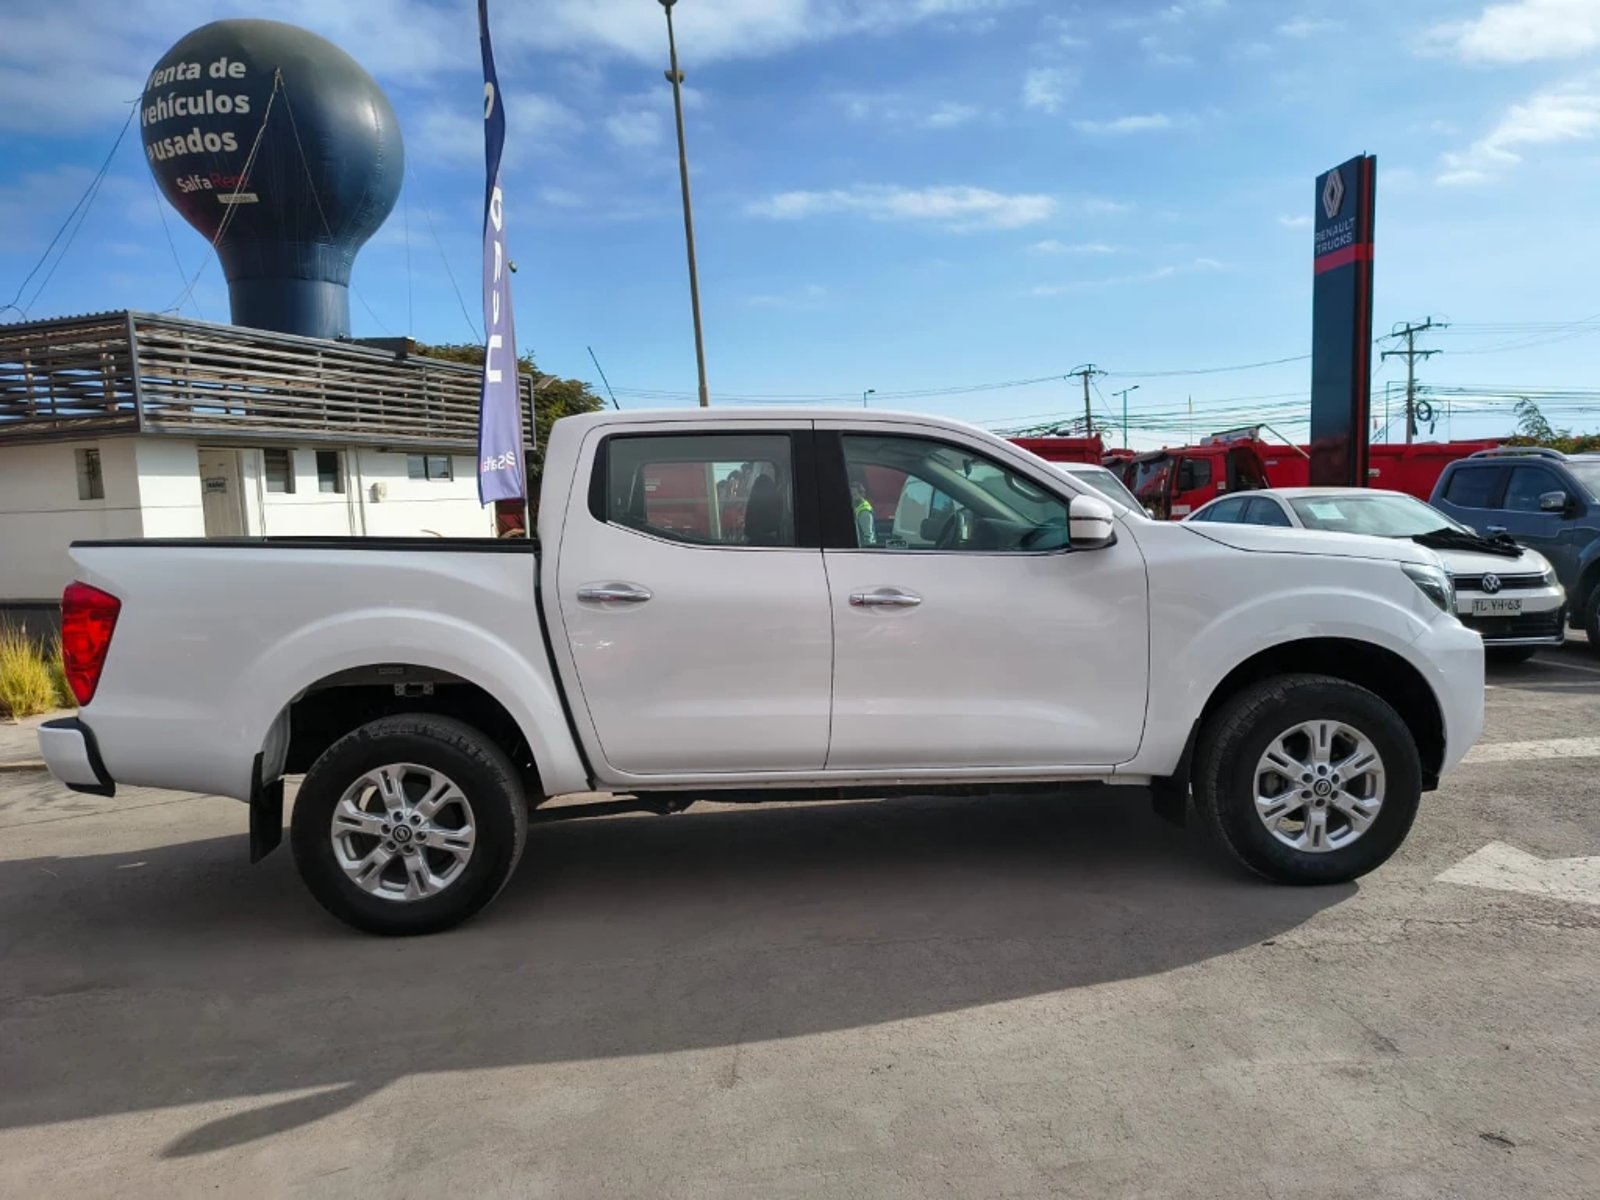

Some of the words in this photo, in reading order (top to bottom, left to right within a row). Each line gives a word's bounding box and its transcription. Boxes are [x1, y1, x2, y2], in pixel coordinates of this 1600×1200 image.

[209, 57, 246, 78] de
[142, 89, 250, 127] vehículos
[1315, 217, 1355, 240] RENAULT
[1316, 233, 1352, 254] TRUCKS
